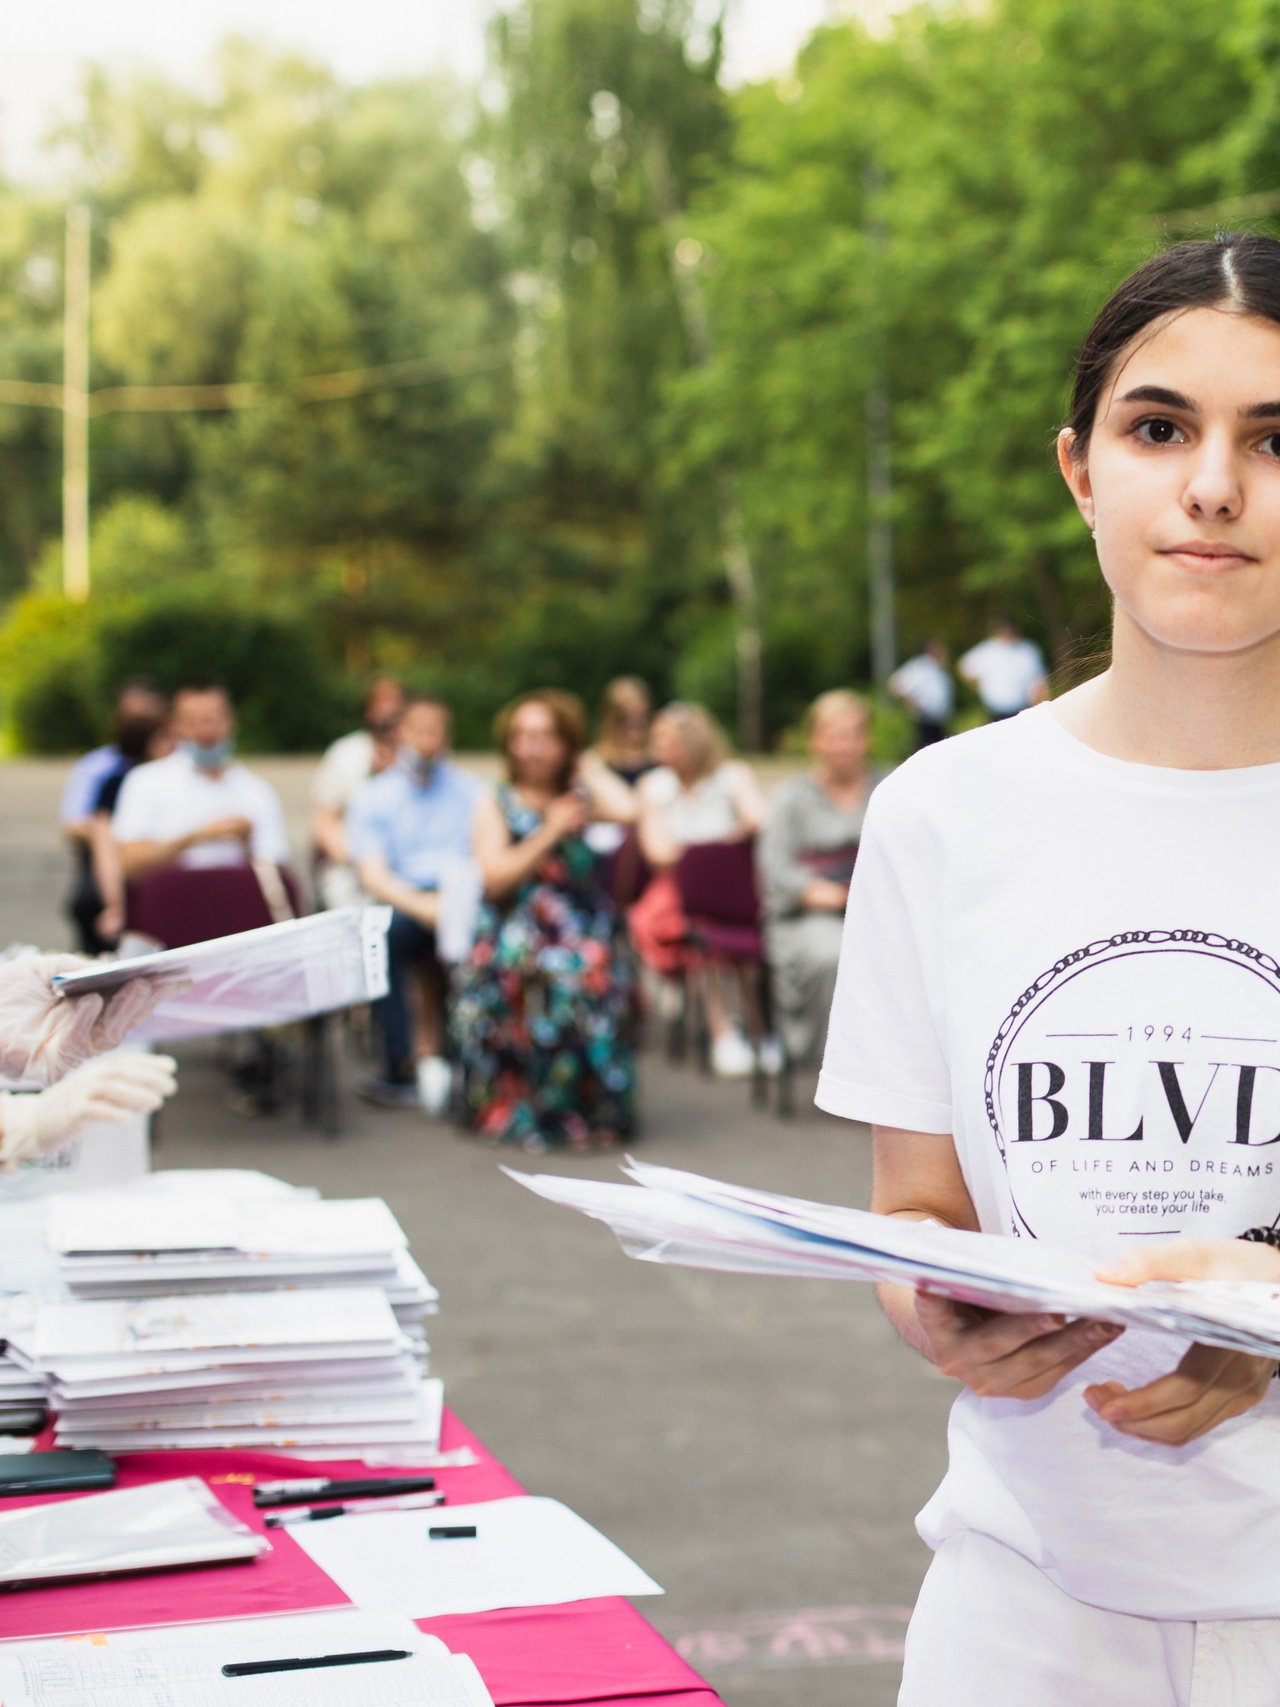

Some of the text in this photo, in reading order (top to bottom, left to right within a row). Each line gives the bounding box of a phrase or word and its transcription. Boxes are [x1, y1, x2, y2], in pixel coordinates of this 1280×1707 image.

[1126, 1025, 1193, 1043] 1994
[1031, 1159, 1274, 1177] OF LIFE AND DREAMS
[1079, 1188, 1102, 1200] with
[1105, 1190, 1138, 1203] every
[1142, 1189, 1170, 1202] step
[1173, 1190, 1196, 1203] you
[1095, 1200, 1211, 1217] you create your life
